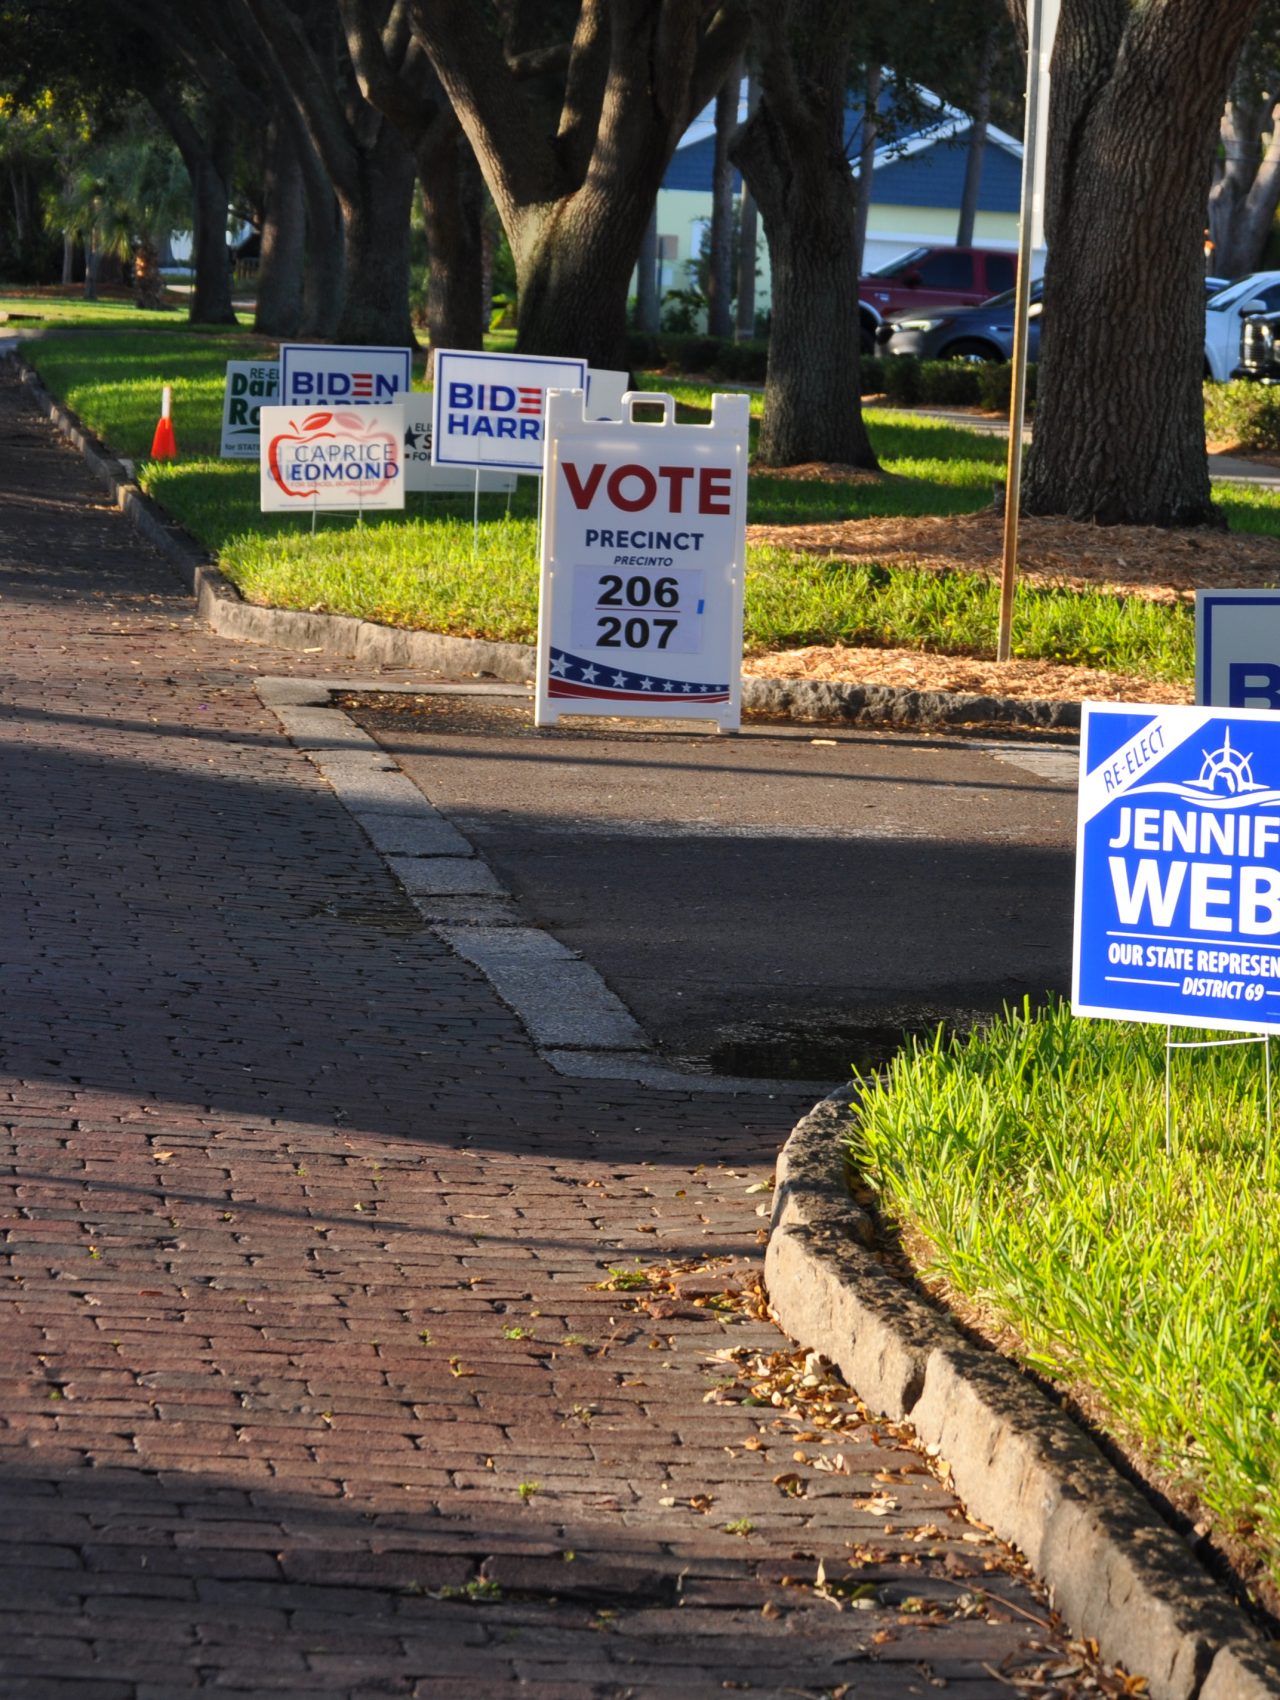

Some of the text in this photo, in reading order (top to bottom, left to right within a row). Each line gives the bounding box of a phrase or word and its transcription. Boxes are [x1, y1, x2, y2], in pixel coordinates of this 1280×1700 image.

[292, 371, 398, 397] BIDEN
[449, 382, 542, 414] BIDE
[448, 413, 545, 440] HARR
[294, 443, 395, 463] CAPRICE
[291, 462, 399, 481] EDMOND
[561, 462, 732, 515] VOTE
[585, 528, 705, 551] PRECINCT
[613, 555, 673, 567] PRECINTO
[597, 574, 680, 609] 206
[595, 617, 679, 649] 207
[1103, 724, 1165, 793] RE-ELECT
[1108, 942, 1144, 967] OUR
[1146, 945, 1193, 972] STATE
[1182, 976, 1265, 1002] DISTRICT 69
